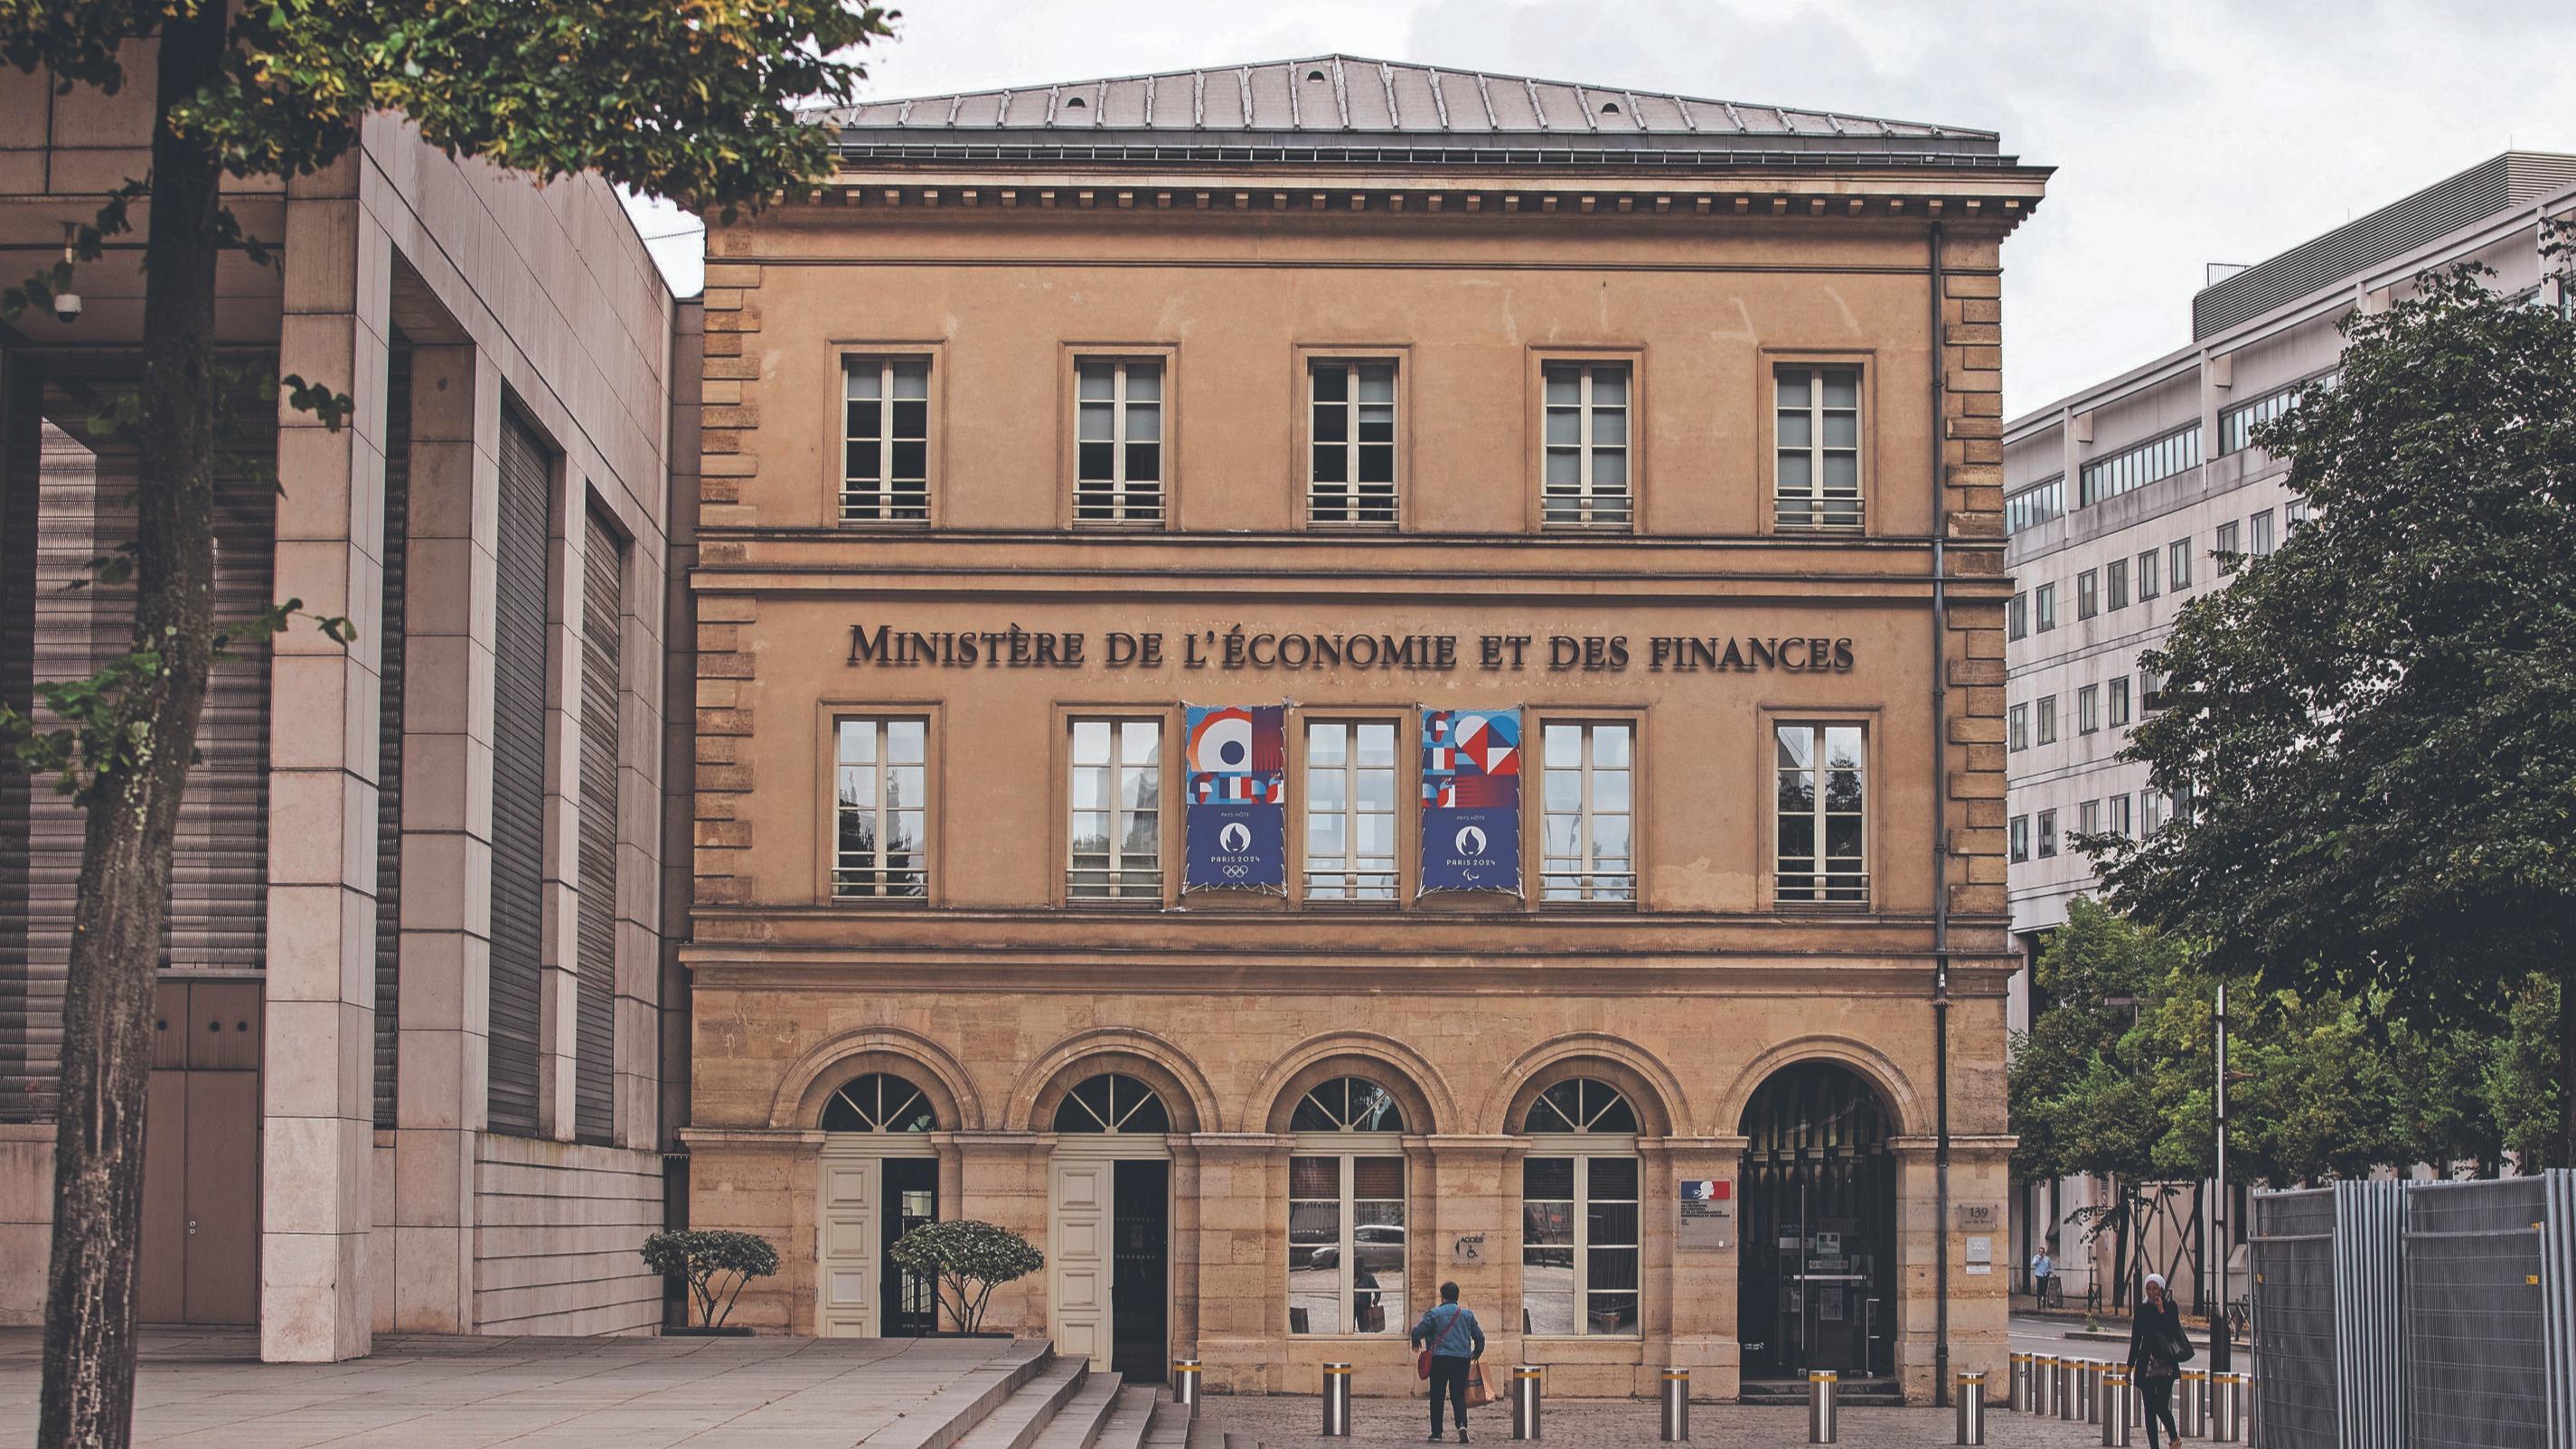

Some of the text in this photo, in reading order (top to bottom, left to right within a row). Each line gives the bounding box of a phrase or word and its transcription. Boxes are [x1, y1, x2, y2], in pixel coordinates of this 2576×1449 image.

[847, 621, 1086, 665] MINISTÈRE
[1105, 632, 1164, 665] DE
[1479, 635, 1532, 667] ET
[1548, 635, 1630, 668] DES
[1649, 635, 1855, 670] FINANCES
[1970, 1207, 1988, 1218] 139
